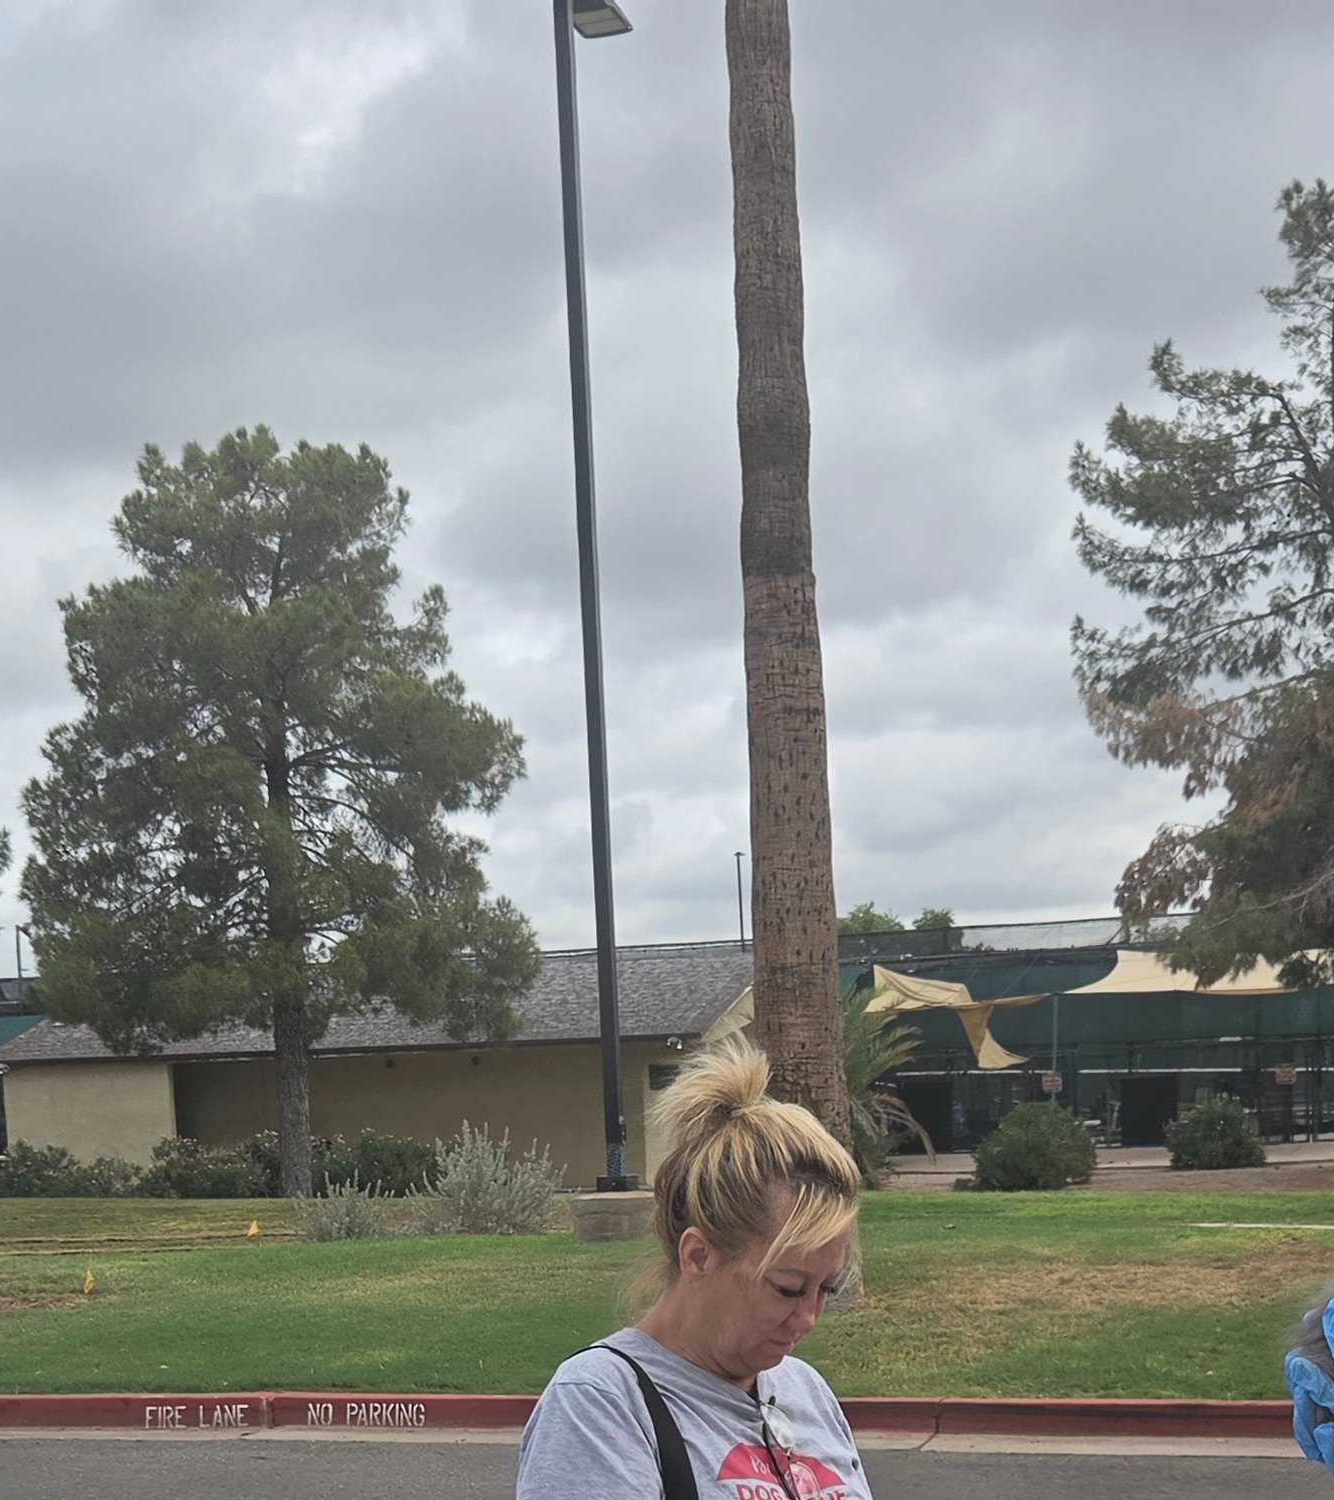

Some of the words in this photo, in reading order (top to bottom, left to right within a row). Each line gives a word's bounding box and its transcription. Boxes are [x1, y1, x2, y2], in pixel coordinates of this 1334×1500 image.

[145, 1405, 187, 1429] FIRE
[199, 1404, 249, 1428] LANE
[307, 1403, 334, 1426] NO
[346, 1403, 426, 1427] PARKING
